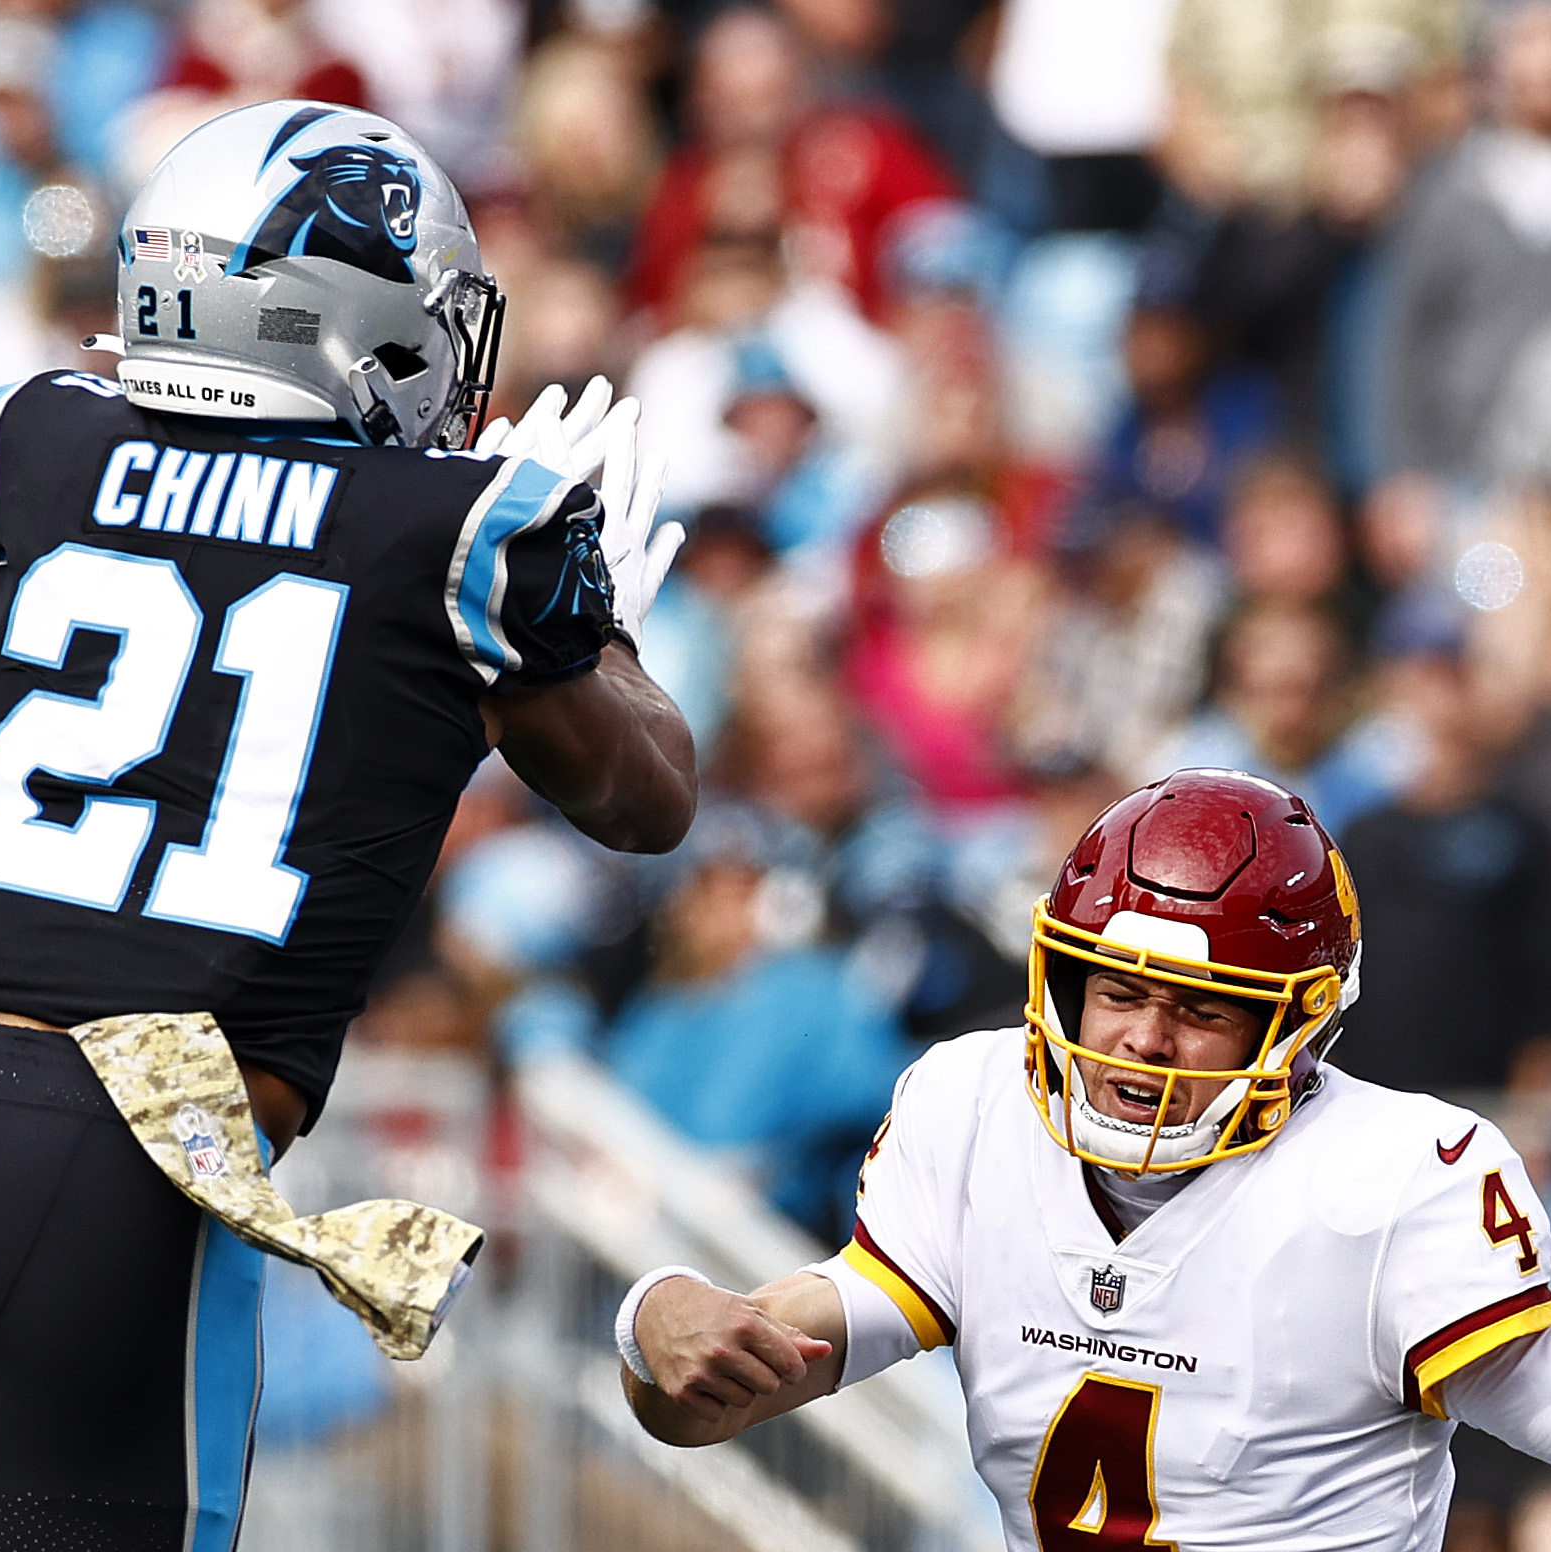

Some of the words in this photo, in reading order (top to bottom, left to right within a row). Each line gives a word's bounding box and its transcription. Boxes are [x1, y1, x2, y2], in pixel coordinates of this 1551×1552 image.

[137, 285, 197, 340] 21
[167, 383, 196, 400] ALL
[201, 387, 224, 403] OF
[230, 391, 256, 408] US
[91, 440, 339, 550] CHINN
[1479, 1168, 1542, 1277] 4
[1093, 1287, 1118, 1309] NFL
[1021, 1325, 1198, 1373] WASHINGTON
